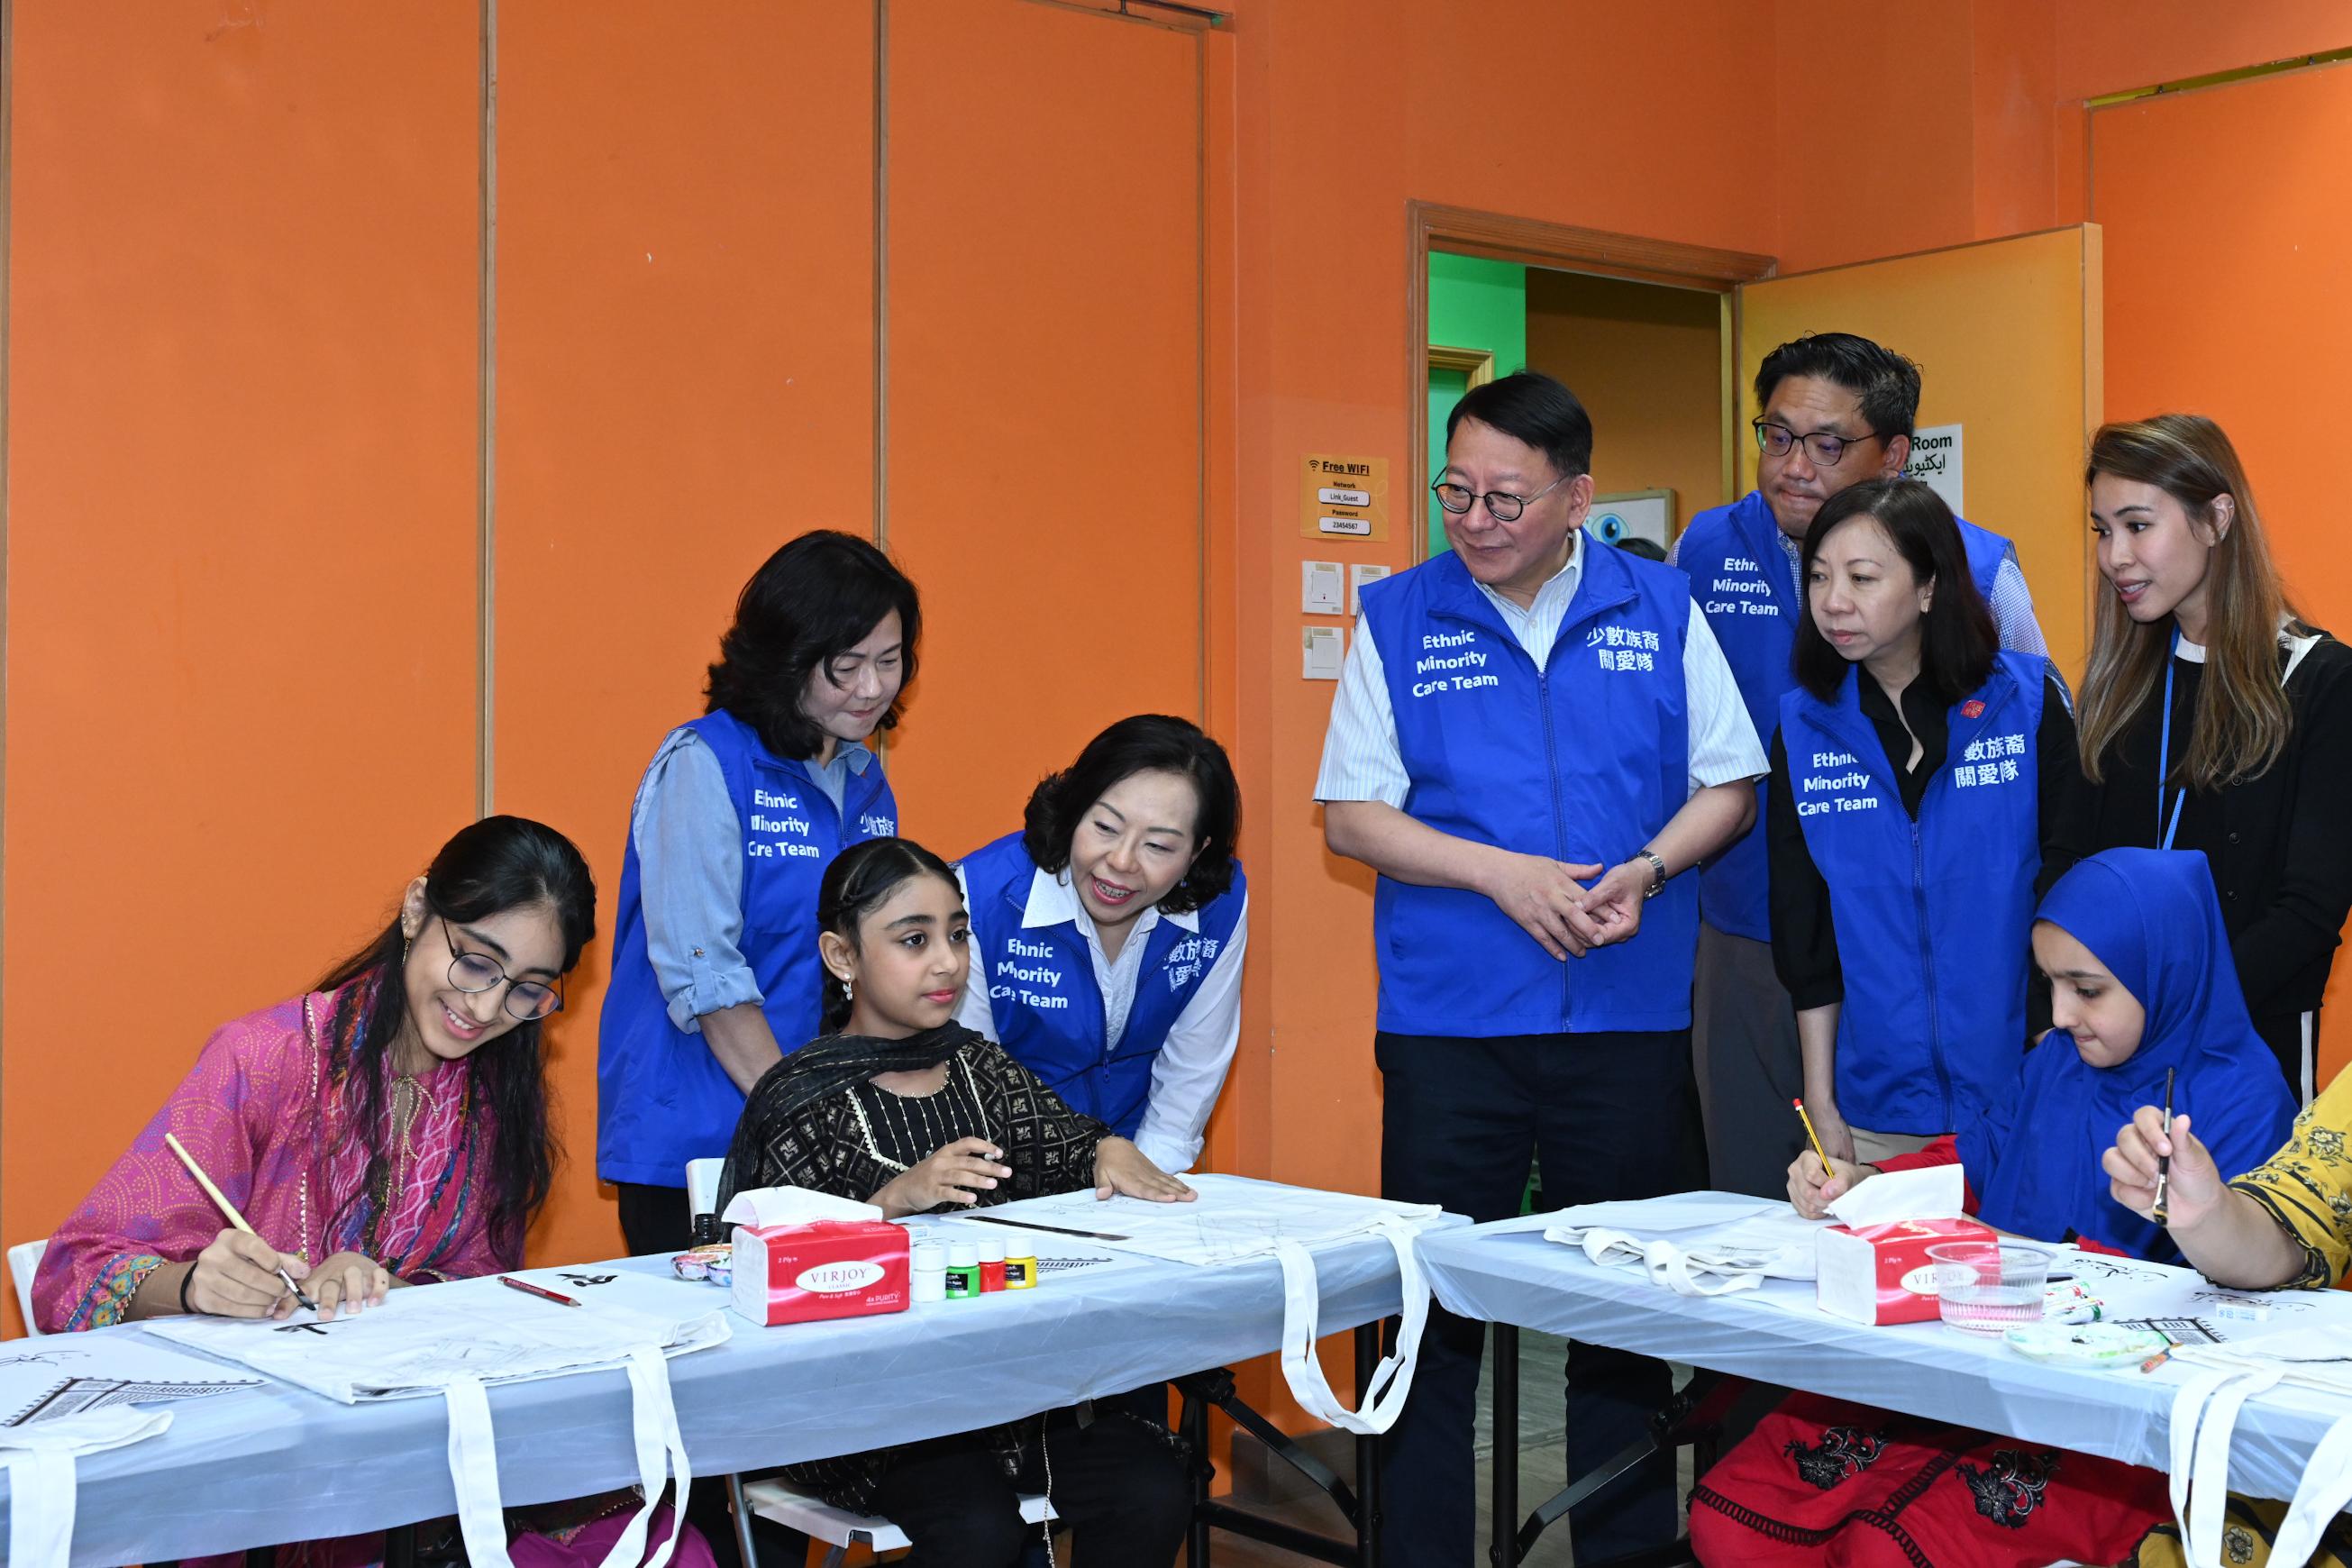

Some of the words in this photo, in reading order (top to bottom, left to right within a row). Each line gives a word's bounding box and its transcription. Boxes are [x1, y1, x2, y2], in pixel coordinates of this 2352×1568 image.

[1911, 436, 1952, 451] Room
[1322, 461, 1345, 472] Free
[1330, 493, 1358, 502] Link_Guest
[1333, 522, 1358, 530] 23454567
[1724, 557, 1759, 571] Ethn
[1706, 600, 1736, 613] Care
[1739, 600, 1779, 615] Team
[1423, 630, 1475, 650] Ethnic
[1586, 625, 1659, 652] 少數族裔
[1416, 651, 1487, 674] Minority
[1598, 649, 1655, 671] 關愛隊
[1412, 680, 1447, 697] Care
[1451, 675, 1499, 690] Team
[1964, 734, 2026, 762] 數族裔
[1803, 772, 1870, 792] Minority
[1955, 759, 2019, 789] 關愛隊
[754, 789, 798, 808] Ehnic
[1797, 801, 1830, 816] Care
[1835, 797, 1878, 813] Team
[748, 841, 772, 857] Cre
[775, 842, 820, 858] Team
[1007, 938, 1053, 958] Ehnic
[997, 961, 1062, 988] Mnority
[1019, 989, 1068, 1008] Team
[811, 1268, 868, 1283] VIRJOY
[875, 1292, 899, 1302] PURITY
